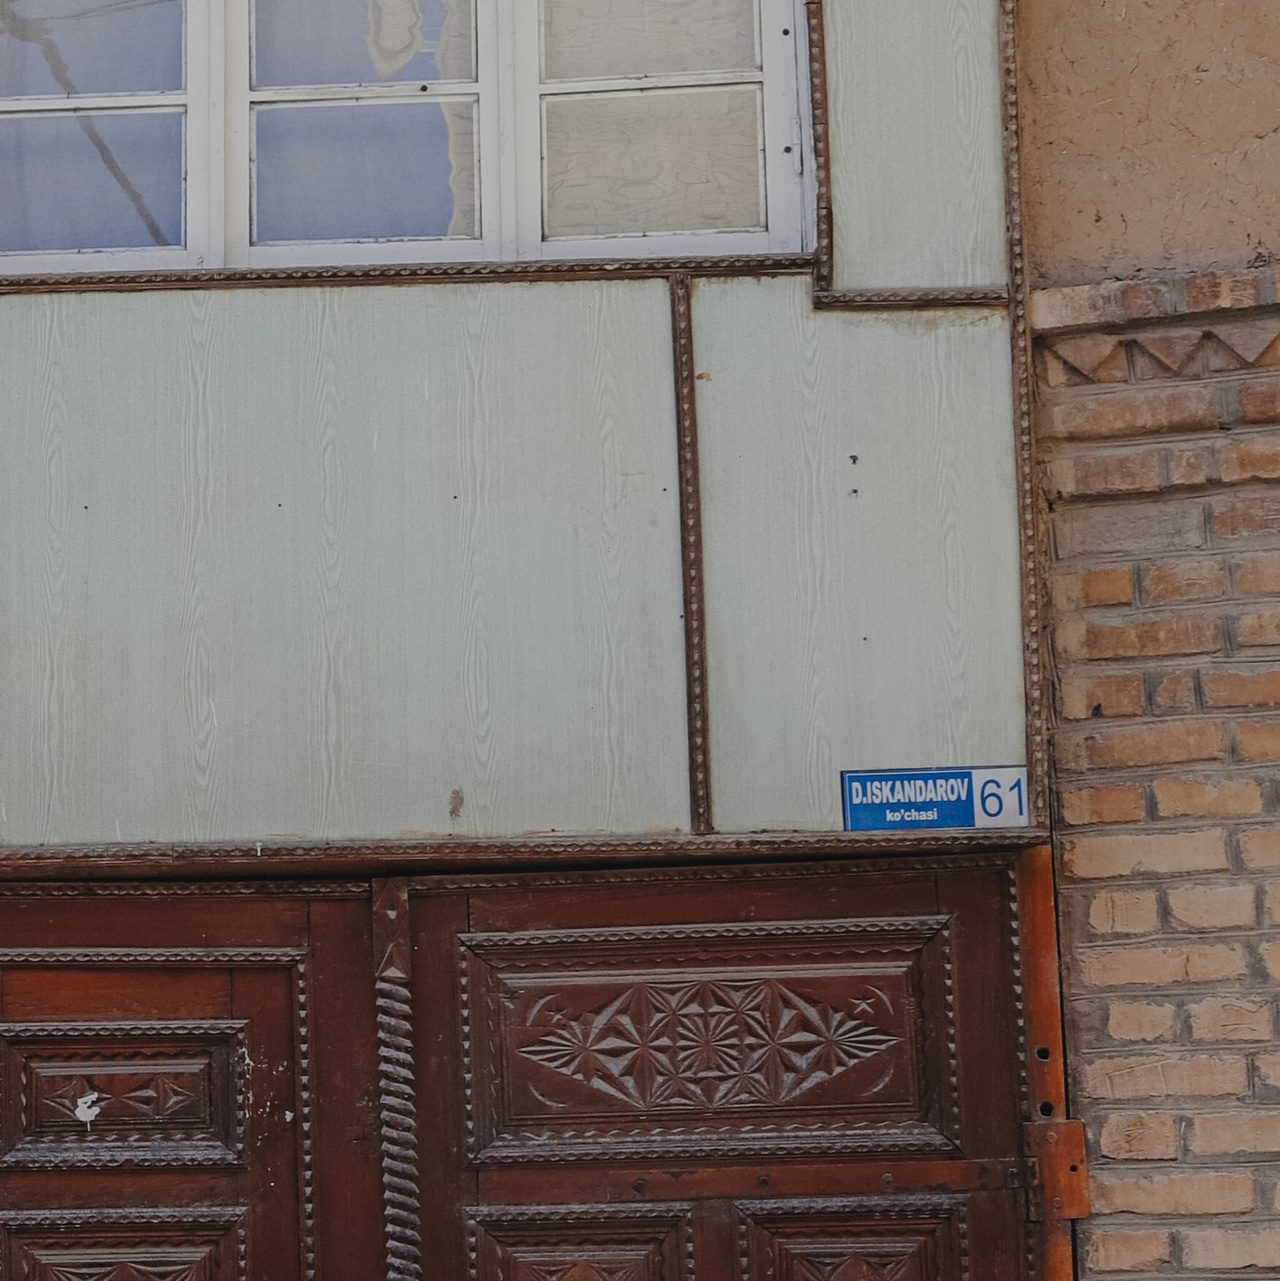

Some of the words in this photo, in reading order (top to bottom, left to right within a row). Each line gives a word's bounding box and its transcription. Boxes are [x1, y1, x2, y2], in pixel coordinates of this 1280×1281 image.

[851, 777, 969, 805] D.ISKANDAROV
[980, 777, 1024, 818] 61
[885, 808, 938, 822] ko'chasi
